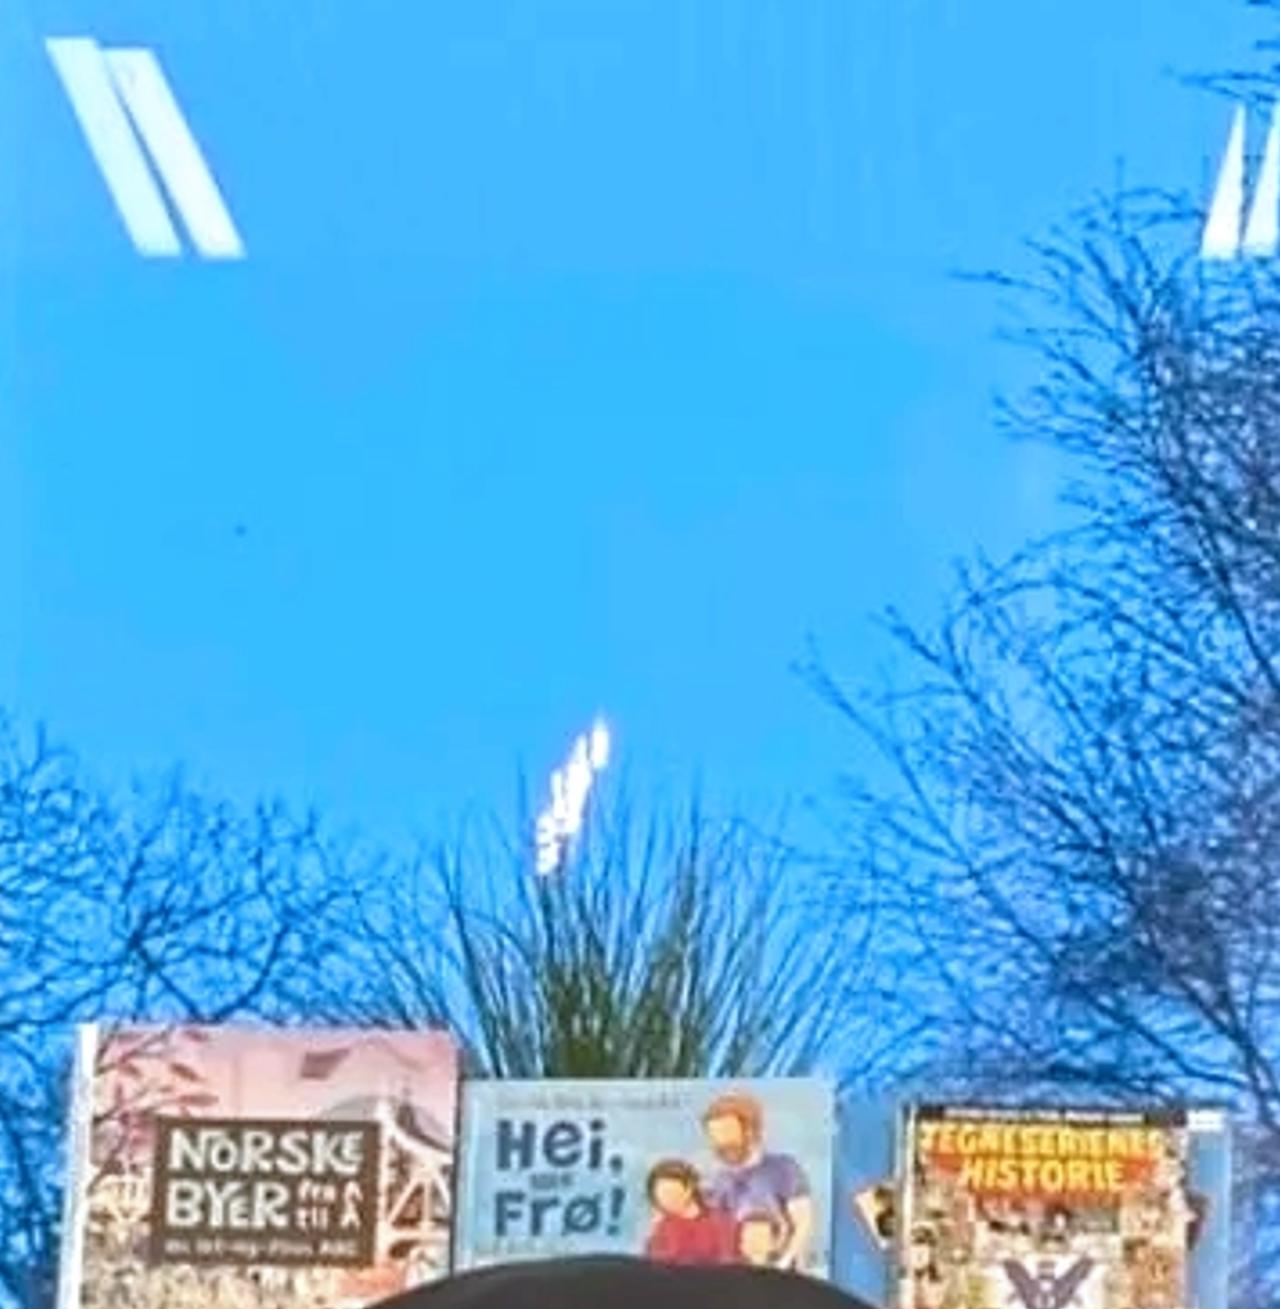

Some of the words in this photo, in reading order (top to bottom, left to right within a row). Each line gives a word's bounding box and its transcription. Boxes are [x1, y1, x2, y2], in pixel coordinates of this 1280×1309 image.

[169, 1129, 364, 1174] NORSKE
[496, 1118, 625, 1176] Hei,
[958, 1157, 1127, 1192] HISTORIE
[166, 1180, 291, 1229] BYER
[494, 1187, 627, 1237] Frø!
